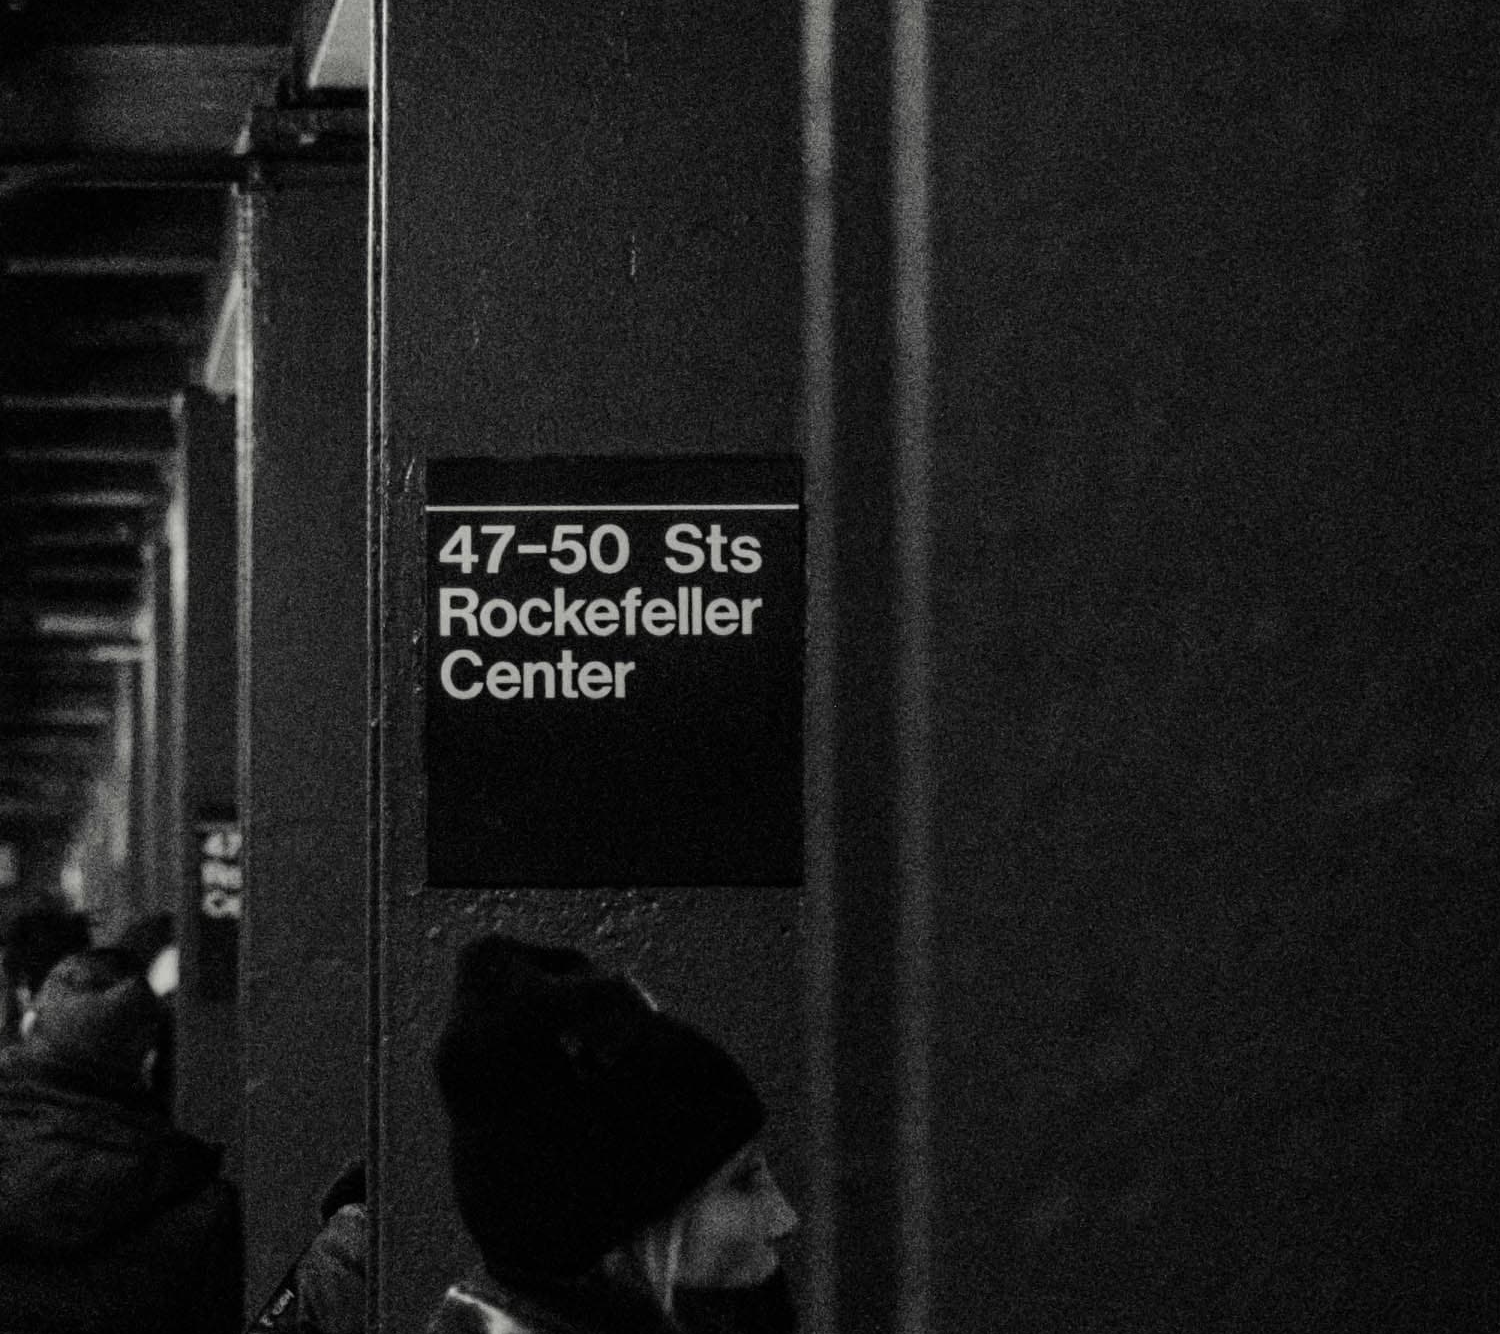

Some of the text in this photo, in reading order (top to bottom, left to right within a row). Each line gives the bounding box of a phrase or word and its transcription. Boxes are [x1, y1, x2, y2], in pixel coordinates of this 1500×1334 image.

[439, 523, 763, 574] 47-50 Sts
[439, 586, 763, 637] Rockefeller
[440, 649, 636, 700] Center
